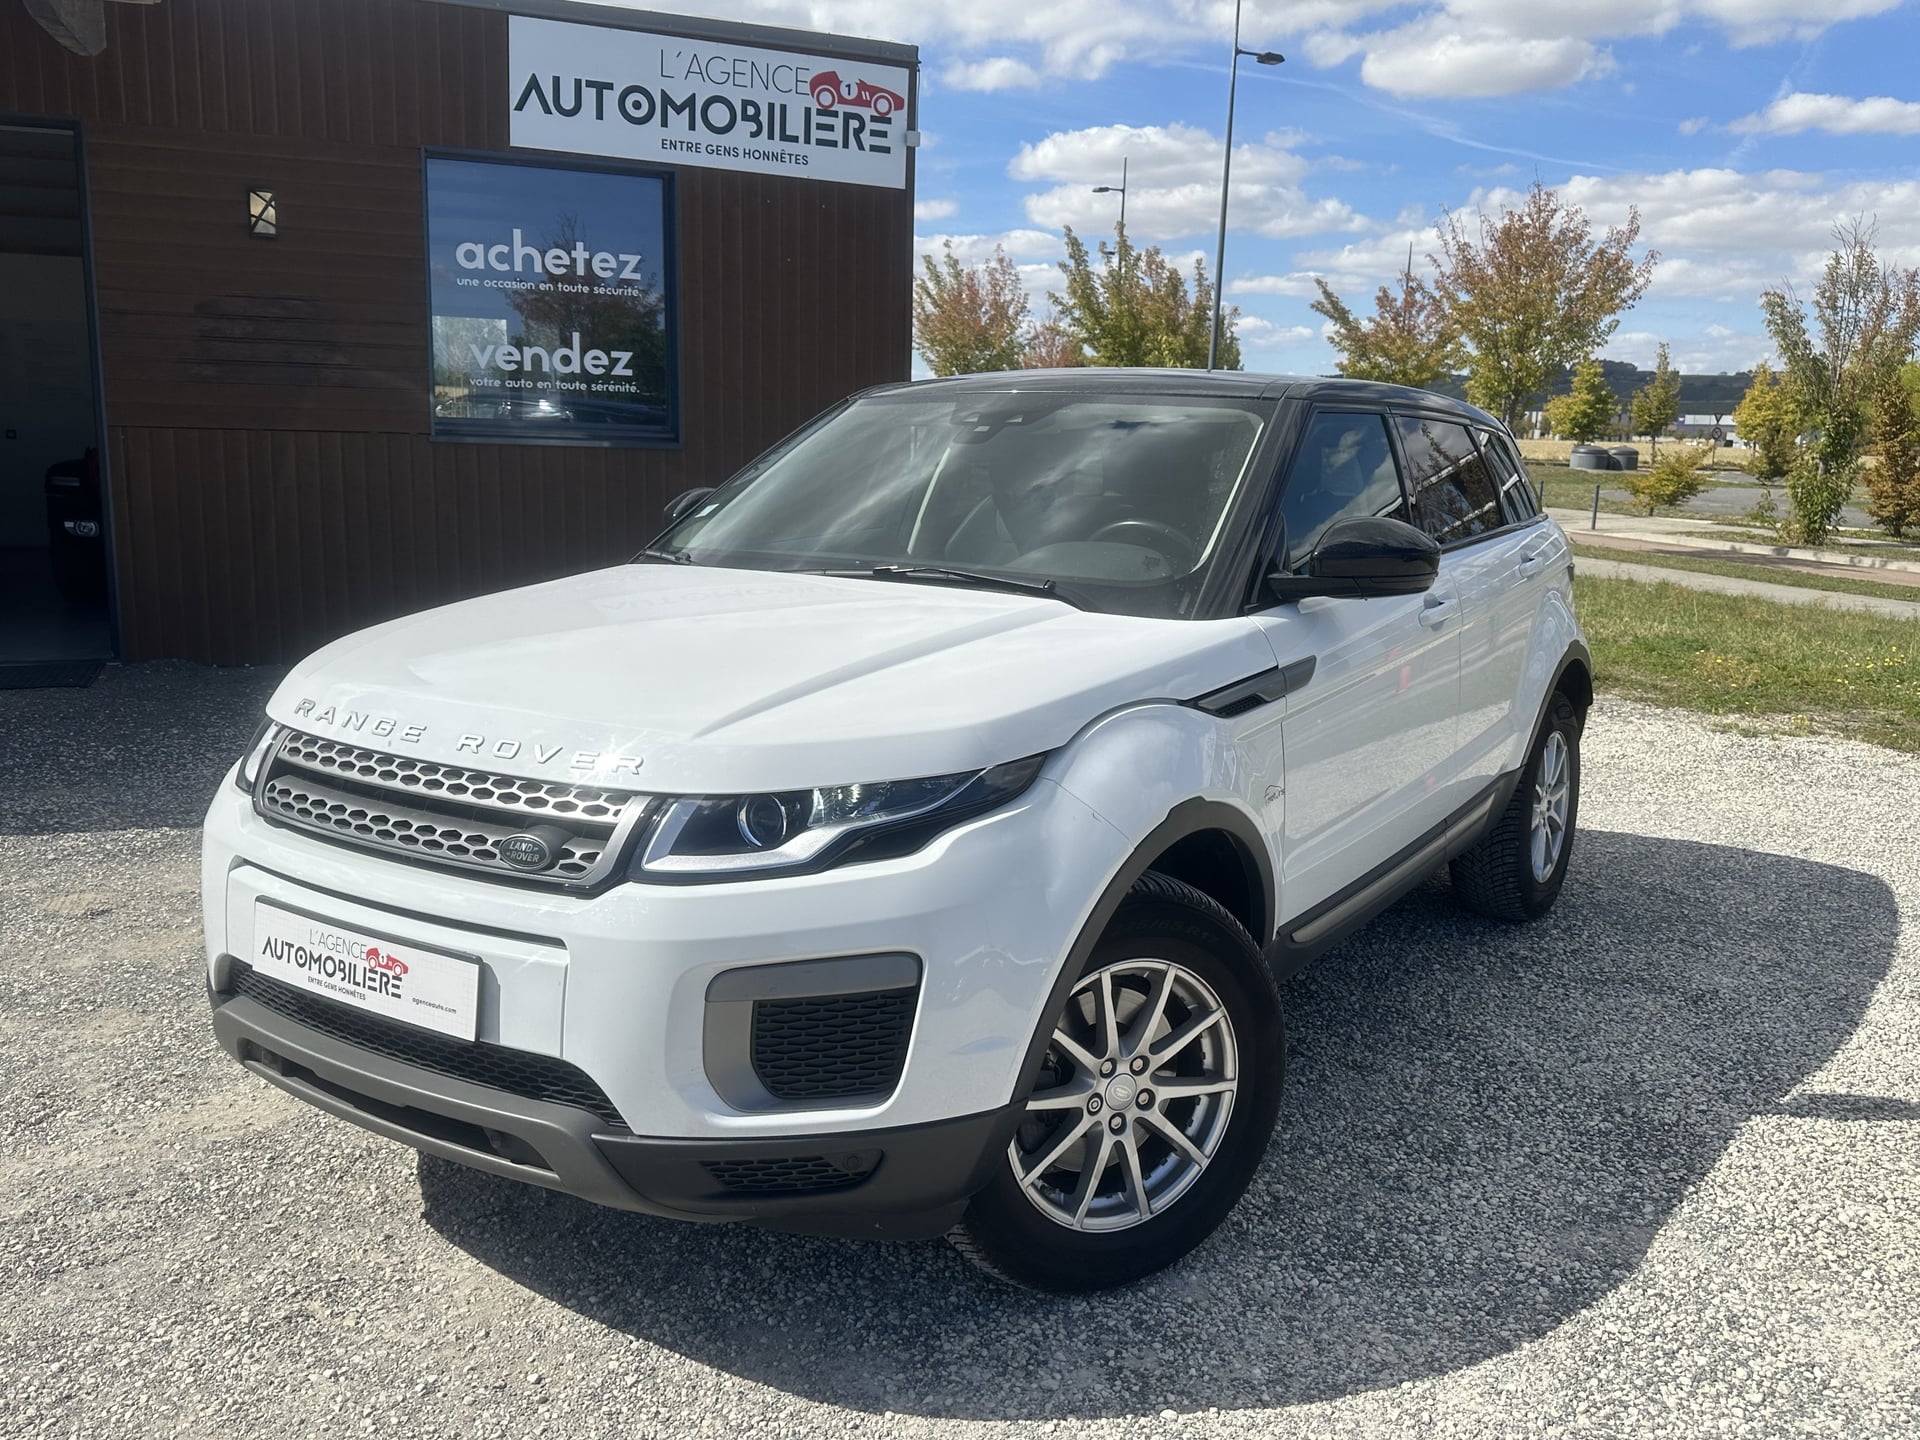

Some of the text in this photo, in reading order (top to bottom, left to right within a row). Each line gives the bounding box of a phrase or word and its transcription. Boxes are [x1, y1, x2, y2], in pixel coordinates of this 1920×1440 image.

[845, 84, 852, 96] 1
[513, 73, 892, 155] AUTOMOBILIERE
[661, 138, 809, 166] ENTRE GENS HONNÊTES
[456, 229, 642, 280] achetez
[457, 277, 480, 287] une
[484, 278, 535, 290] occasion
[539, 283, 554, 292] en
[557, 282, 589, 294] toute
[469, 332, 633, 376] vendez
[469, 378, 501, 388] votre
[505, 379, 533, 389] auto
[555, 380, 587, 391] toute
[294, 698, 645, 776] RANGE ROVER
[510, 841, 534, 852] LAND
[510, 851, 540, 862] ROVER
[308, 976, 323, 986] ENTRE
[324, 982, 337, 991] GENS
